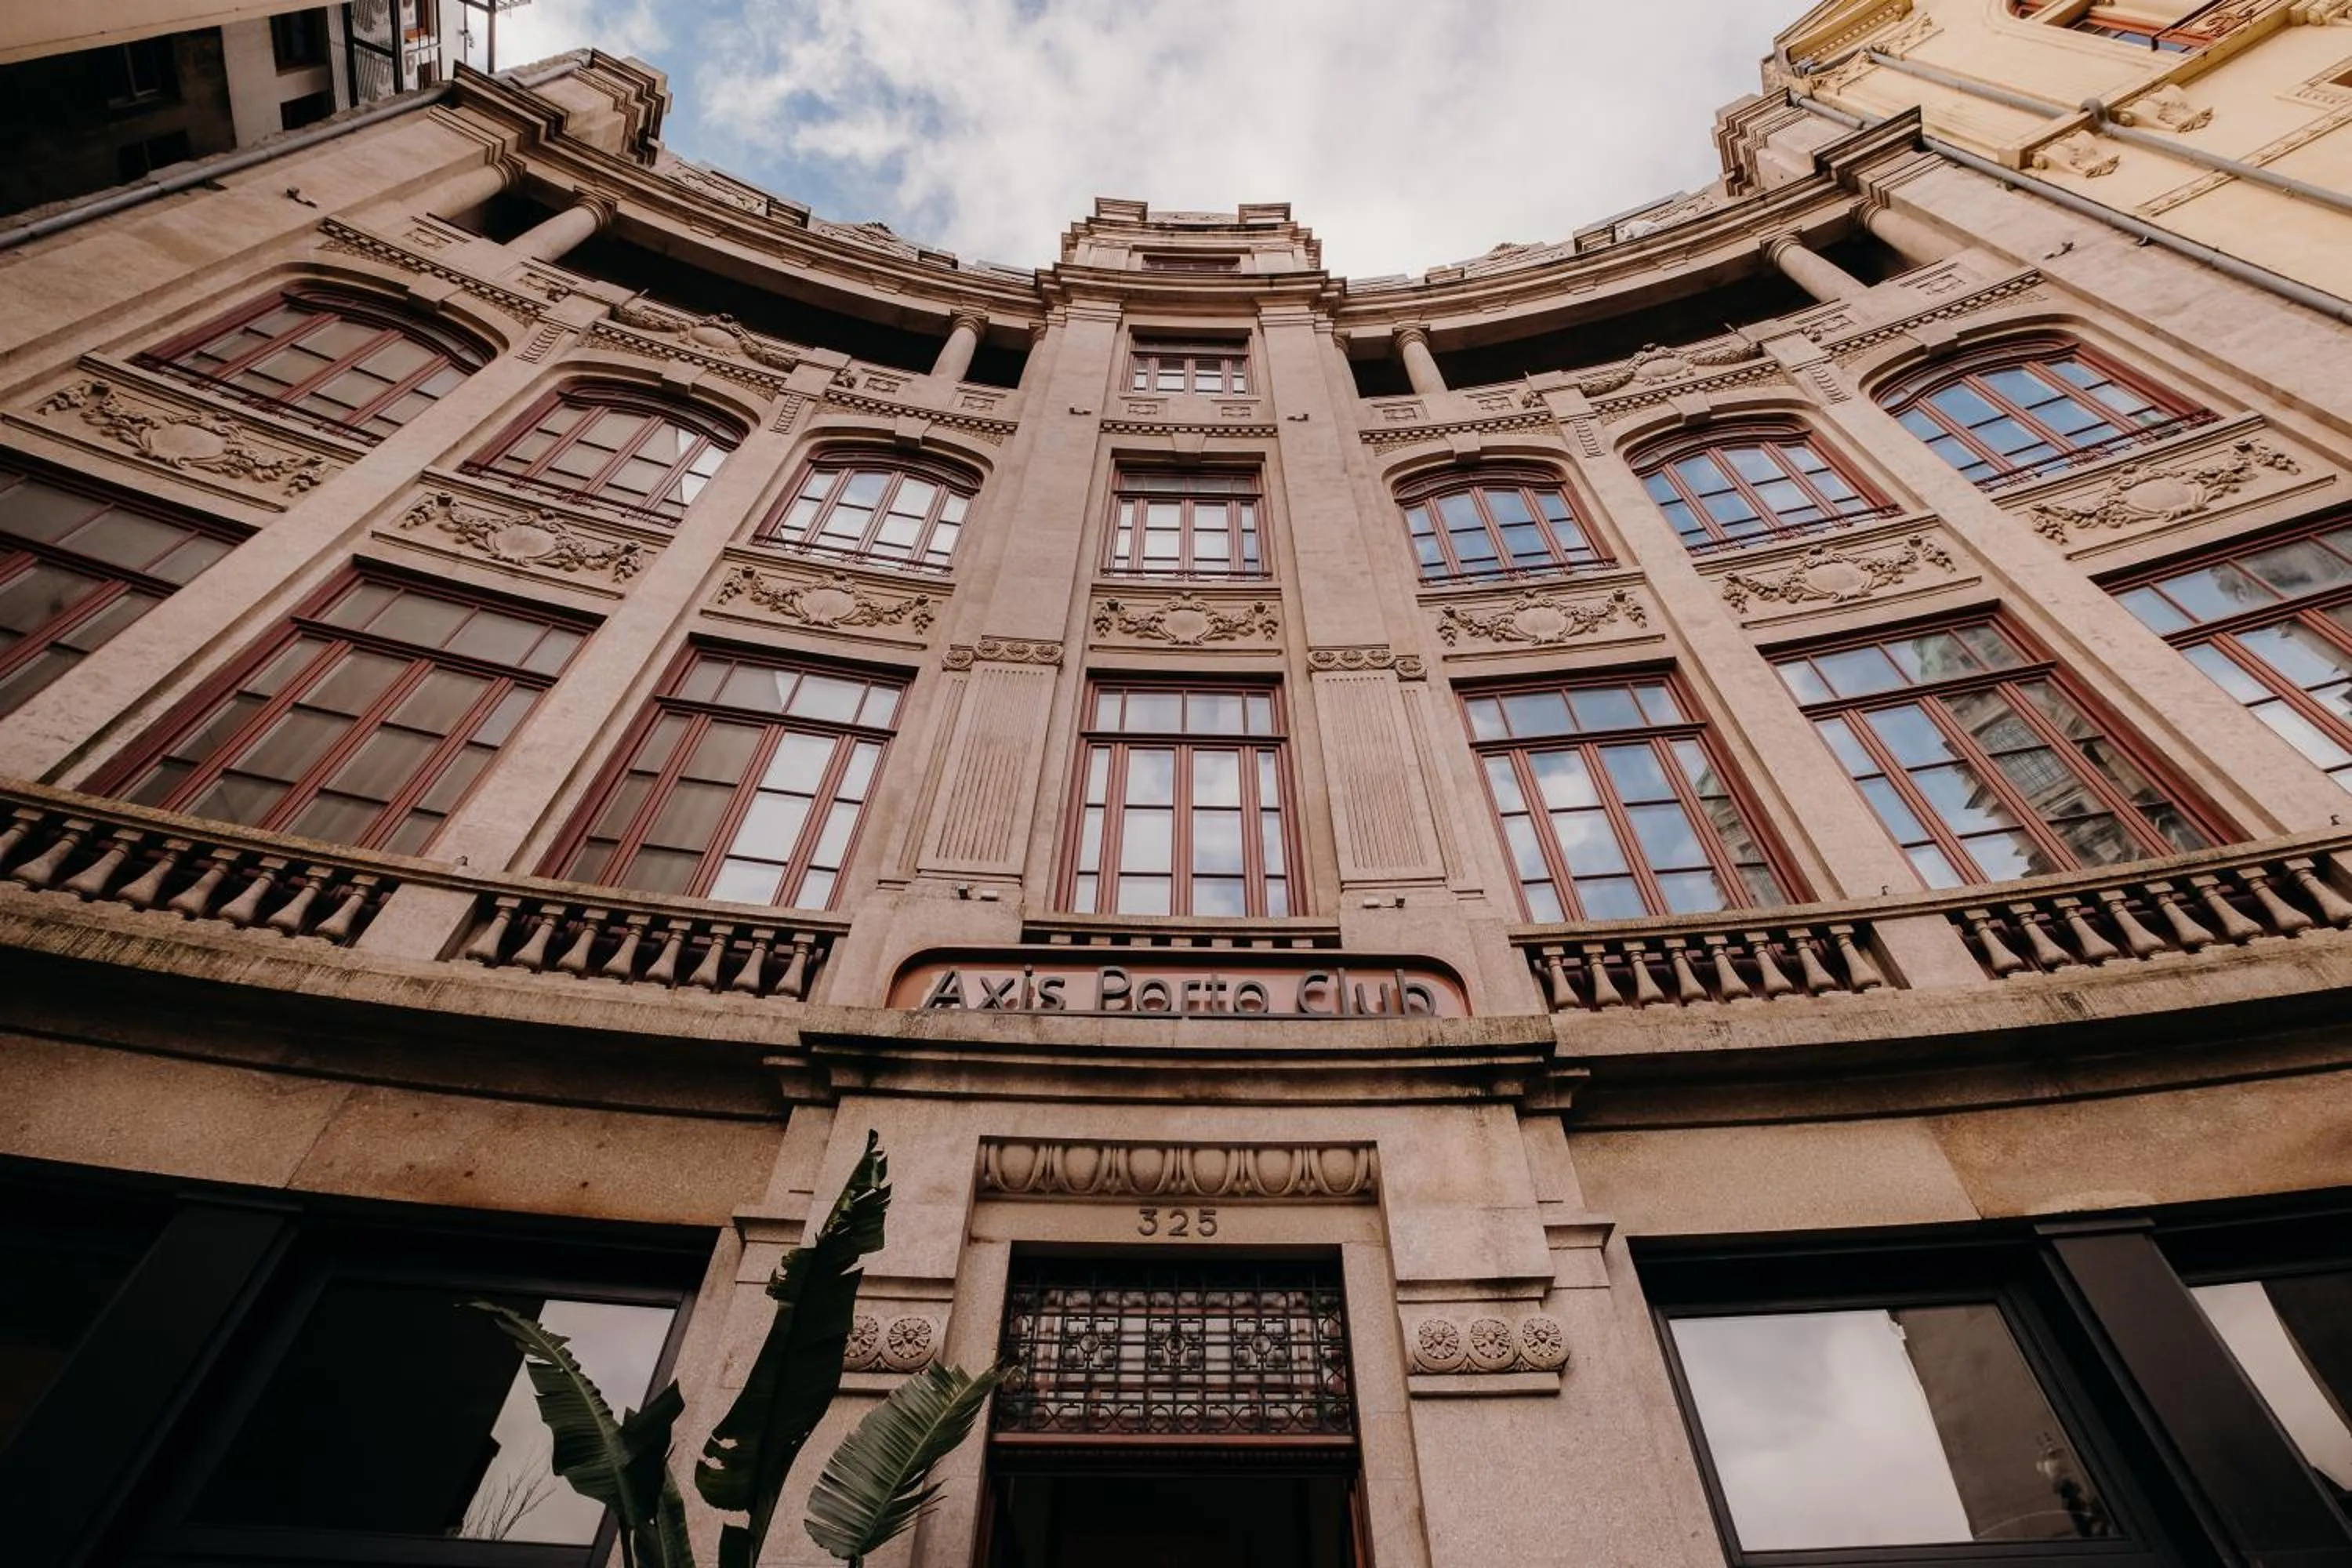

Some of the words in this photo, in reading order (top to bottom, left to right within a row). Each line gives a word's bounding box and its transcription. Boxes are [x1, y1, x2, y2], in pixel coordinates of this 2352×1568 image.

[920, 965, 1065, 1011] Axis
[1094, 966, 1269, 1014] Porto
[1297, 967, 1436, 1018] Club
[1138, 1208, 1218, 1237] 325
